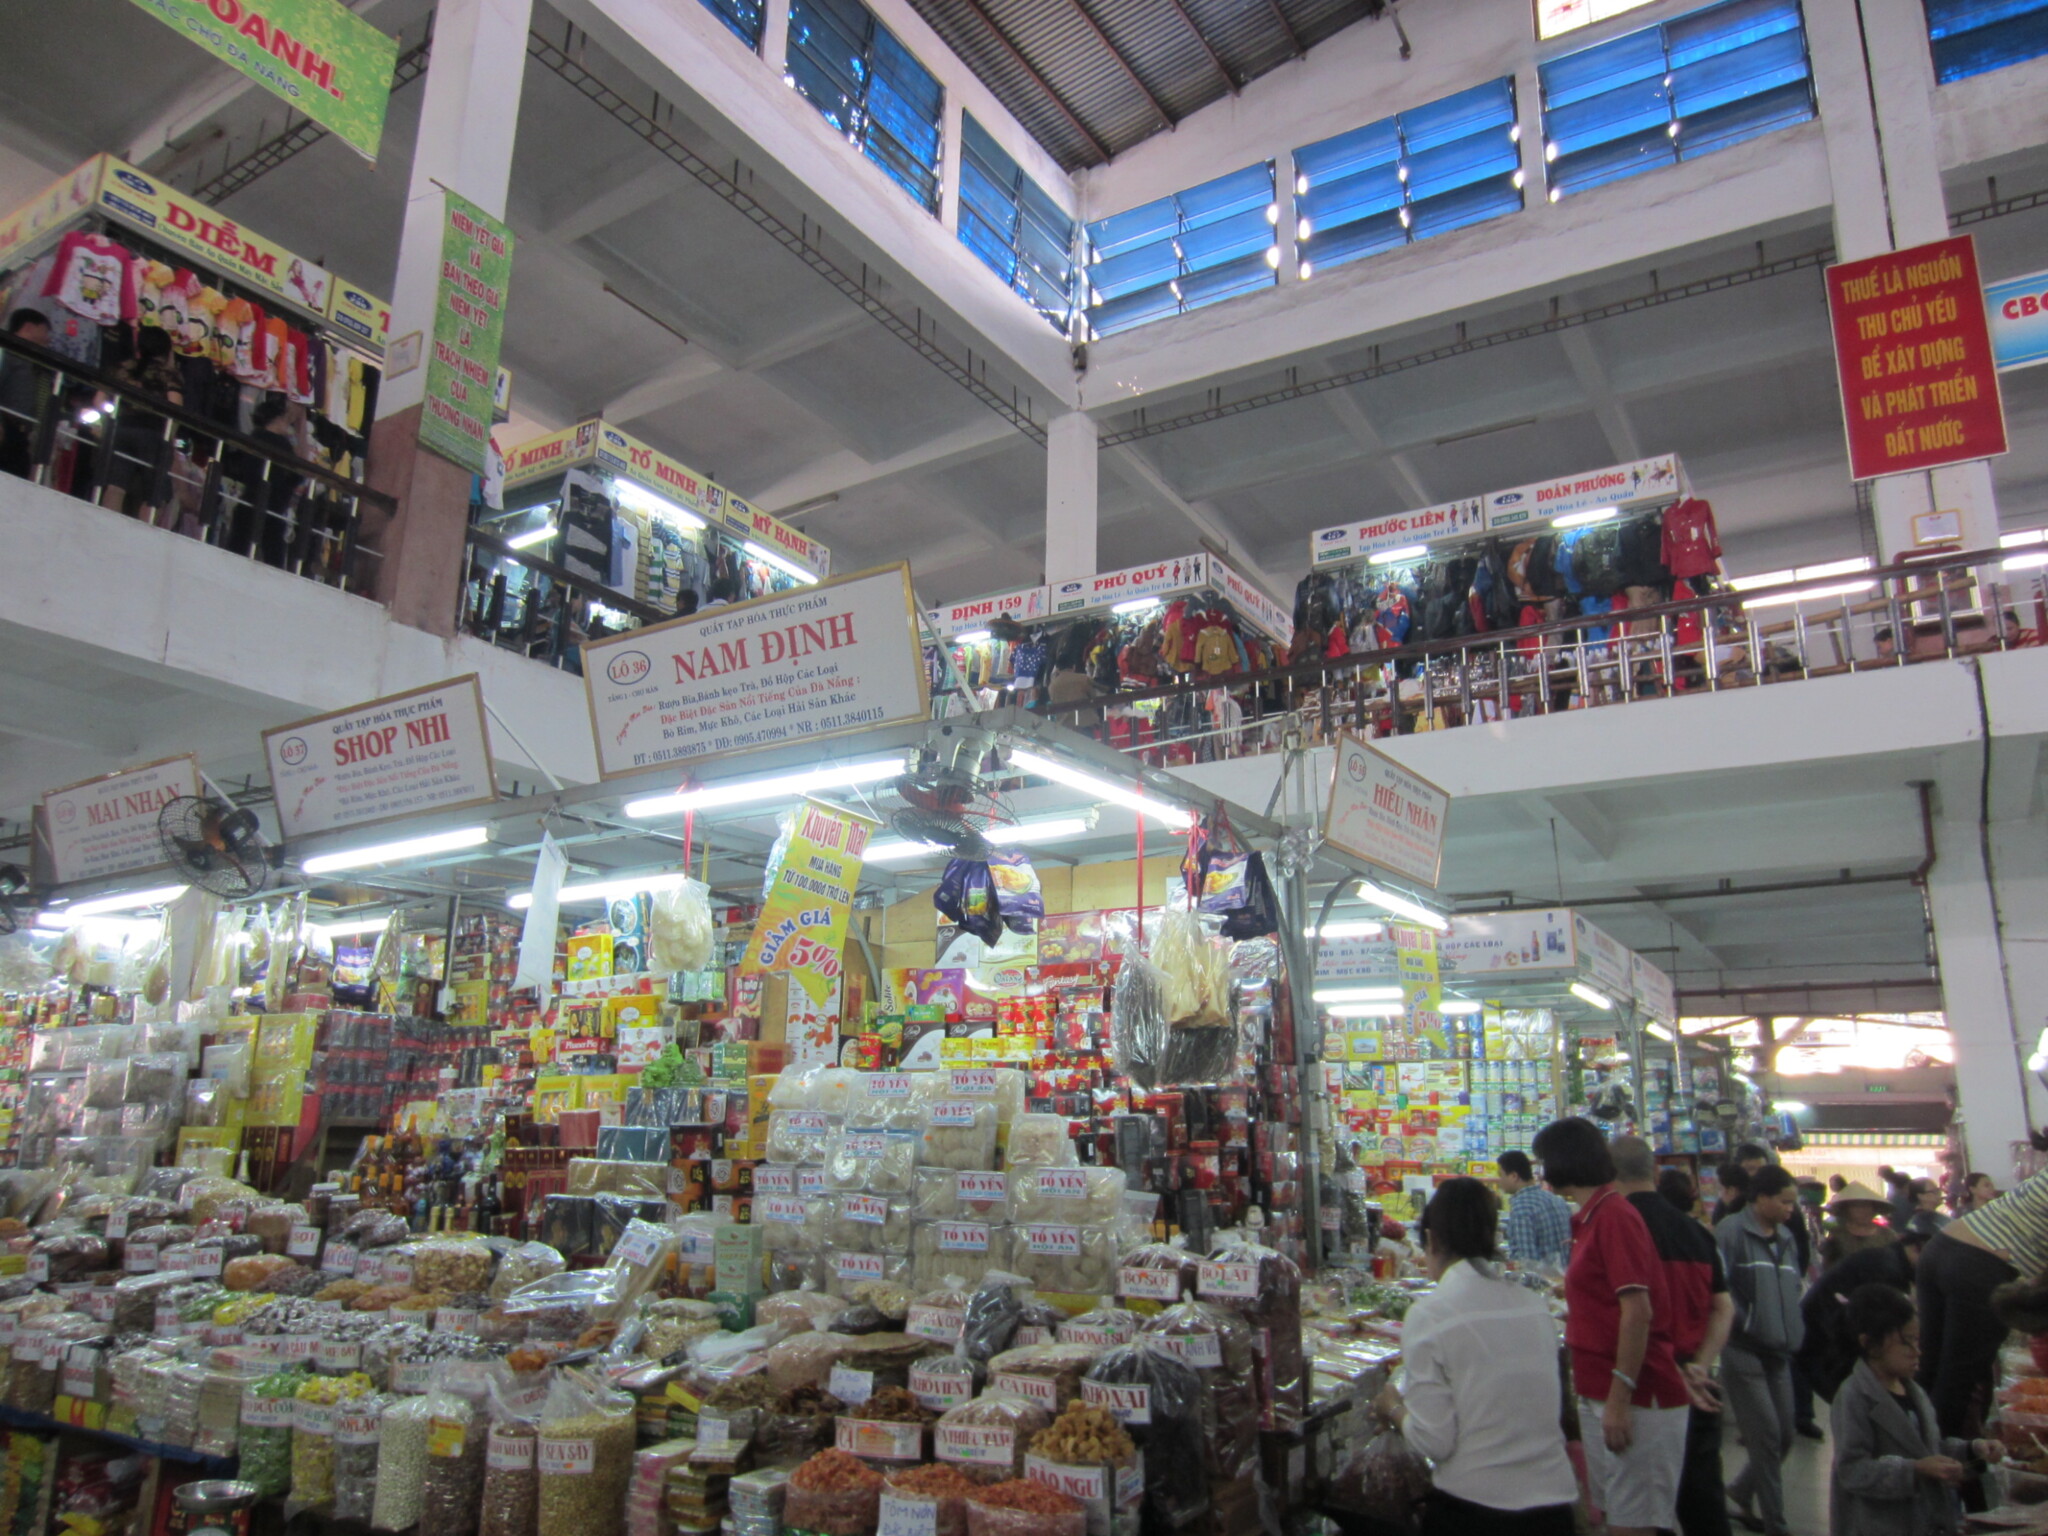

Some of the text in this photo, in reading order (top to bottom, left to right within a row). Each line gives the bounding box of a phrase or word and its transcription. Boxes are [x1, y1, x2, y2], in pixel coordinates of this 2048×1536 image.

[463, 274, 484, 299] THEO
[1841, 266, 1880, 303] THUẾ
[1883, 266, 1903, 294] LÀ
[1857, 290, 1957, 340] THU CHỦ YẾU
[1885, 344, 1915, 375] XÂY
[1919, 337, 1966, 371] DỰNG
[1861, 367, 1979, 420] VÀ PHÁT TRIỂN
[1885, 414, 1965, 457] ĐẤT NƯỚC
[518, 440, 564, 468] MINH
[628, 446, 653, 469] TỐ
[655, 461, 698, 496] MINH
[1411, 510, 1445, 530] LIÊN
[1093, 564, 1168, 591] PHÚ QUÝ
[952, 595, 1022, 621] ĐỊNH 159
[726, 617, 745, 632] TẠP
[672, 612, 858, 685] NAM ĐỊNH
[612, 660, 647, 679] LÔ 36
[817, 661, 839, 677] Loại
[334, 712, 453, 767] SHOP NHI
[796, 721, 813, 734] NR
[86, 798, 121, 827] MAI
[808, 855, 824, 874] MUA
[800, 906, 832, 927] GIÁ
[789, 938, 840, 977] 5%
